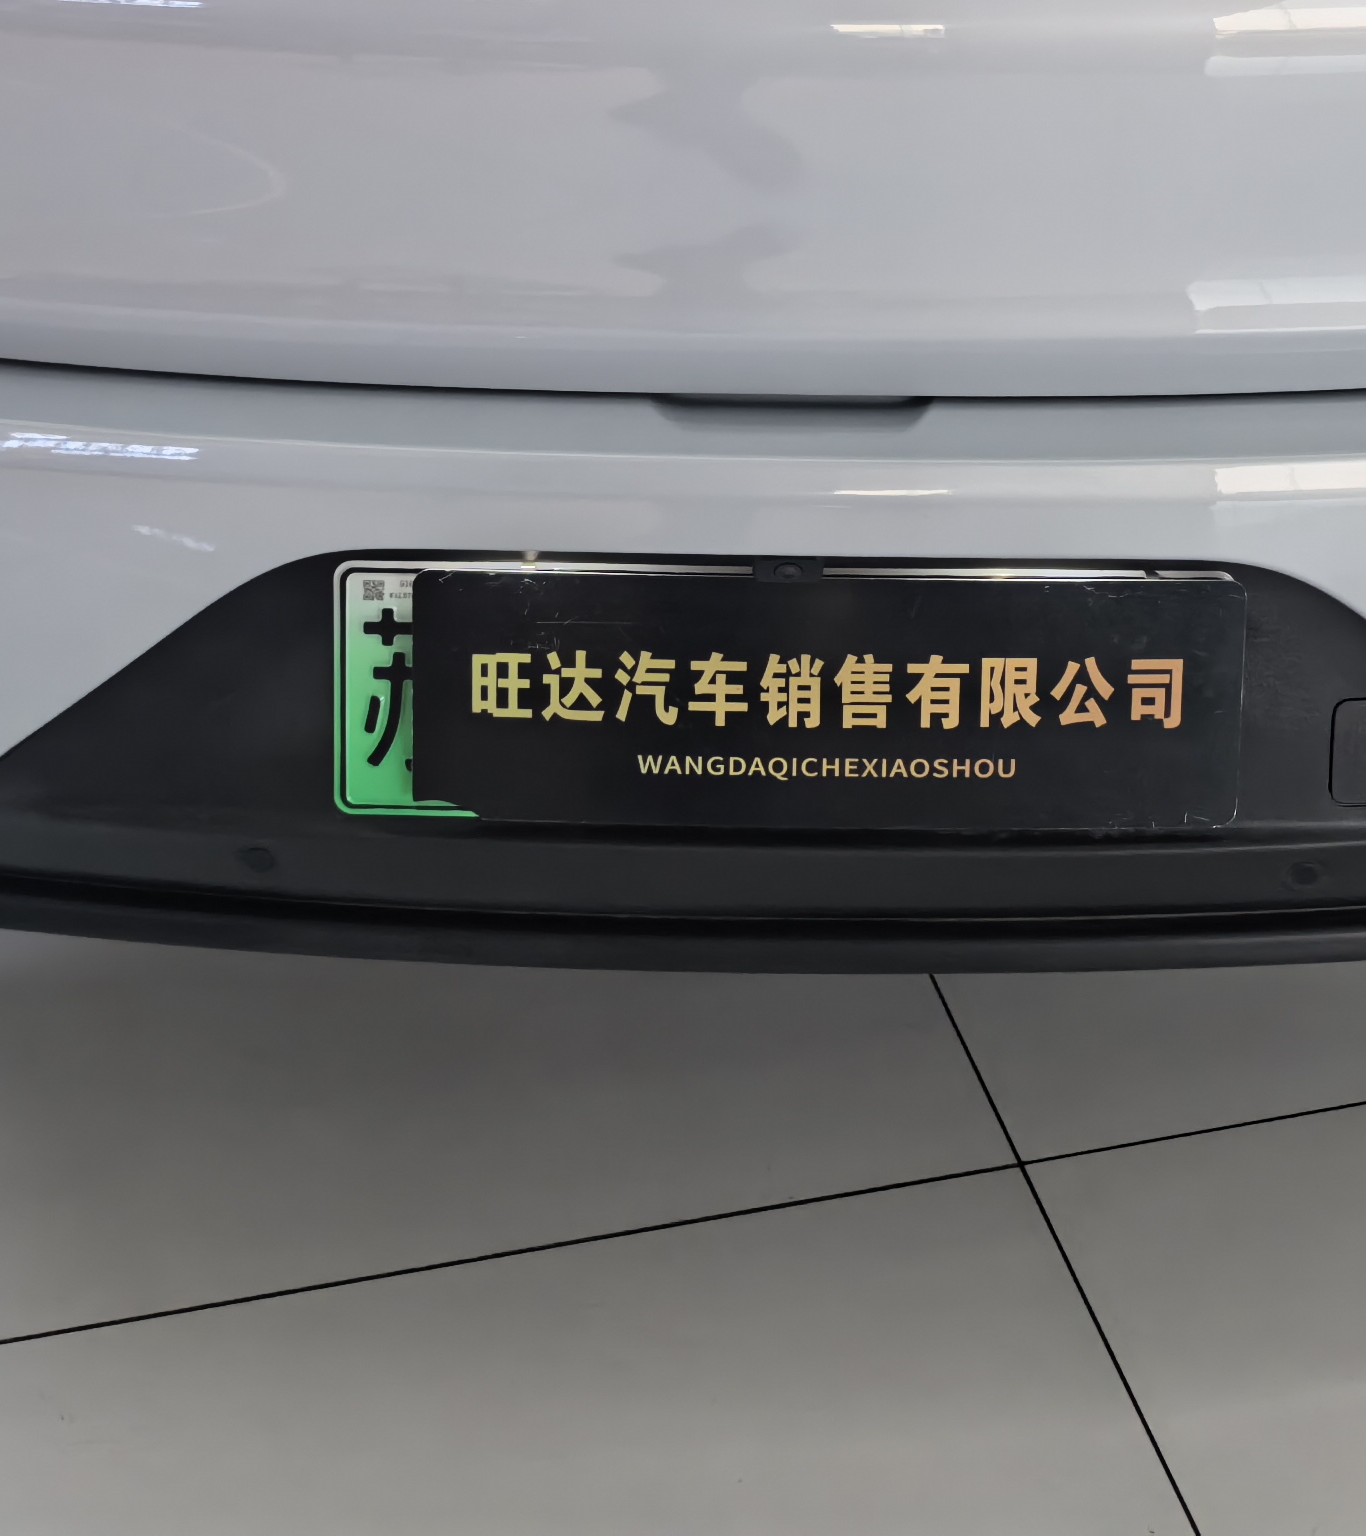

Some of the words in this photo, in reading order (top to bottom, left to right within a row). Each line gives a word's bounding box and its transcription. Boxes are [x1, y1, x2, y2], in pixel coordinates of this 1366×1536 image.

[471, 649, 1184, 730] 旺达汽车销售有限公司
[637, 754, 1017, 780] WANGDAQICHEXIAOSHOU
